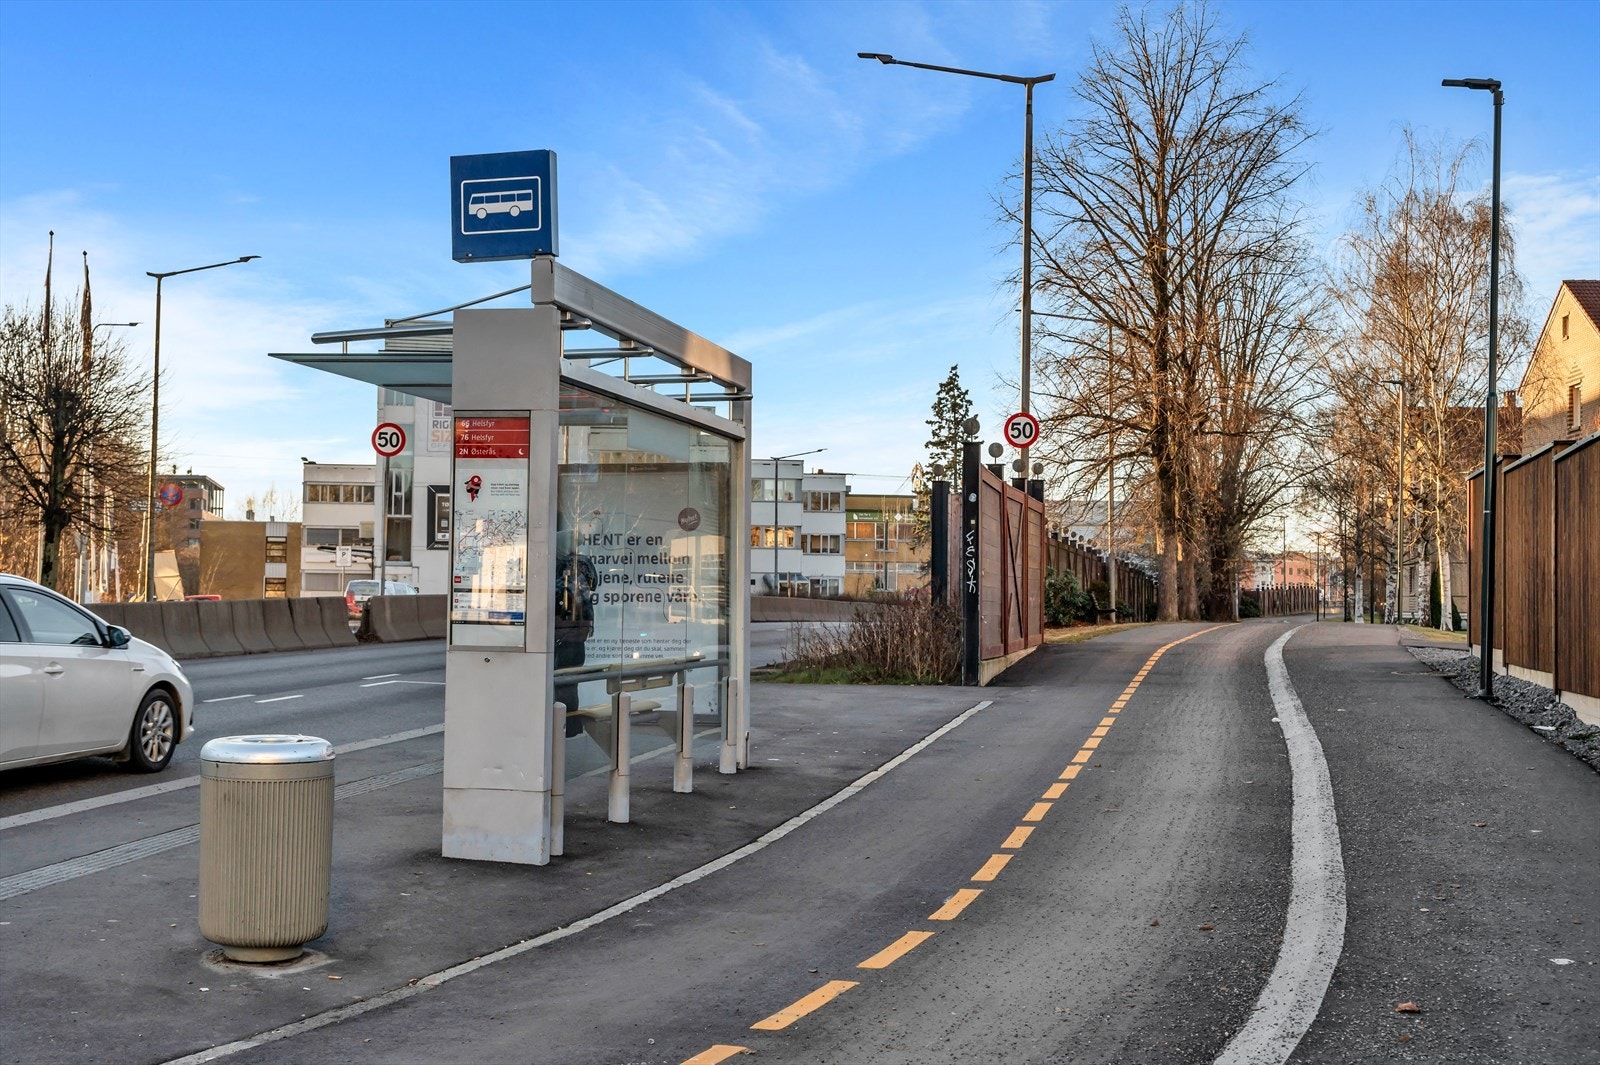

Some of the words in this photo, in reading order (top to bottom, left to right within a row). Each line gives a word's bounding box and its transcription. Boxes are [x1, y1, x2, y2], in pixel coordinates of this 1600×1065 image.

[432, 420, 451, 429] RIG
[472, 419, 495, 428] Helsfyr
[1010, 421, 1034, 439] 50
[377, 431, 400, 448] 50
[460, 433, 469, 441] 76
[471, 433, 495, 442] Helsfyr
[470, 447, 497, 456] Østerås
[583, 533, 623, 546] HENT
[627, 535, 641, 546] er
[646, 535, 663, 546] en
[589, 552, 633, 564] narvei
[637, 552, 690, 564] mellom
[597, 571, 633, 586] jene,
[637, 572, 684, 584] rutene
[590, 593, 599, 605] g
[603, 592, 662, 605] sporene
